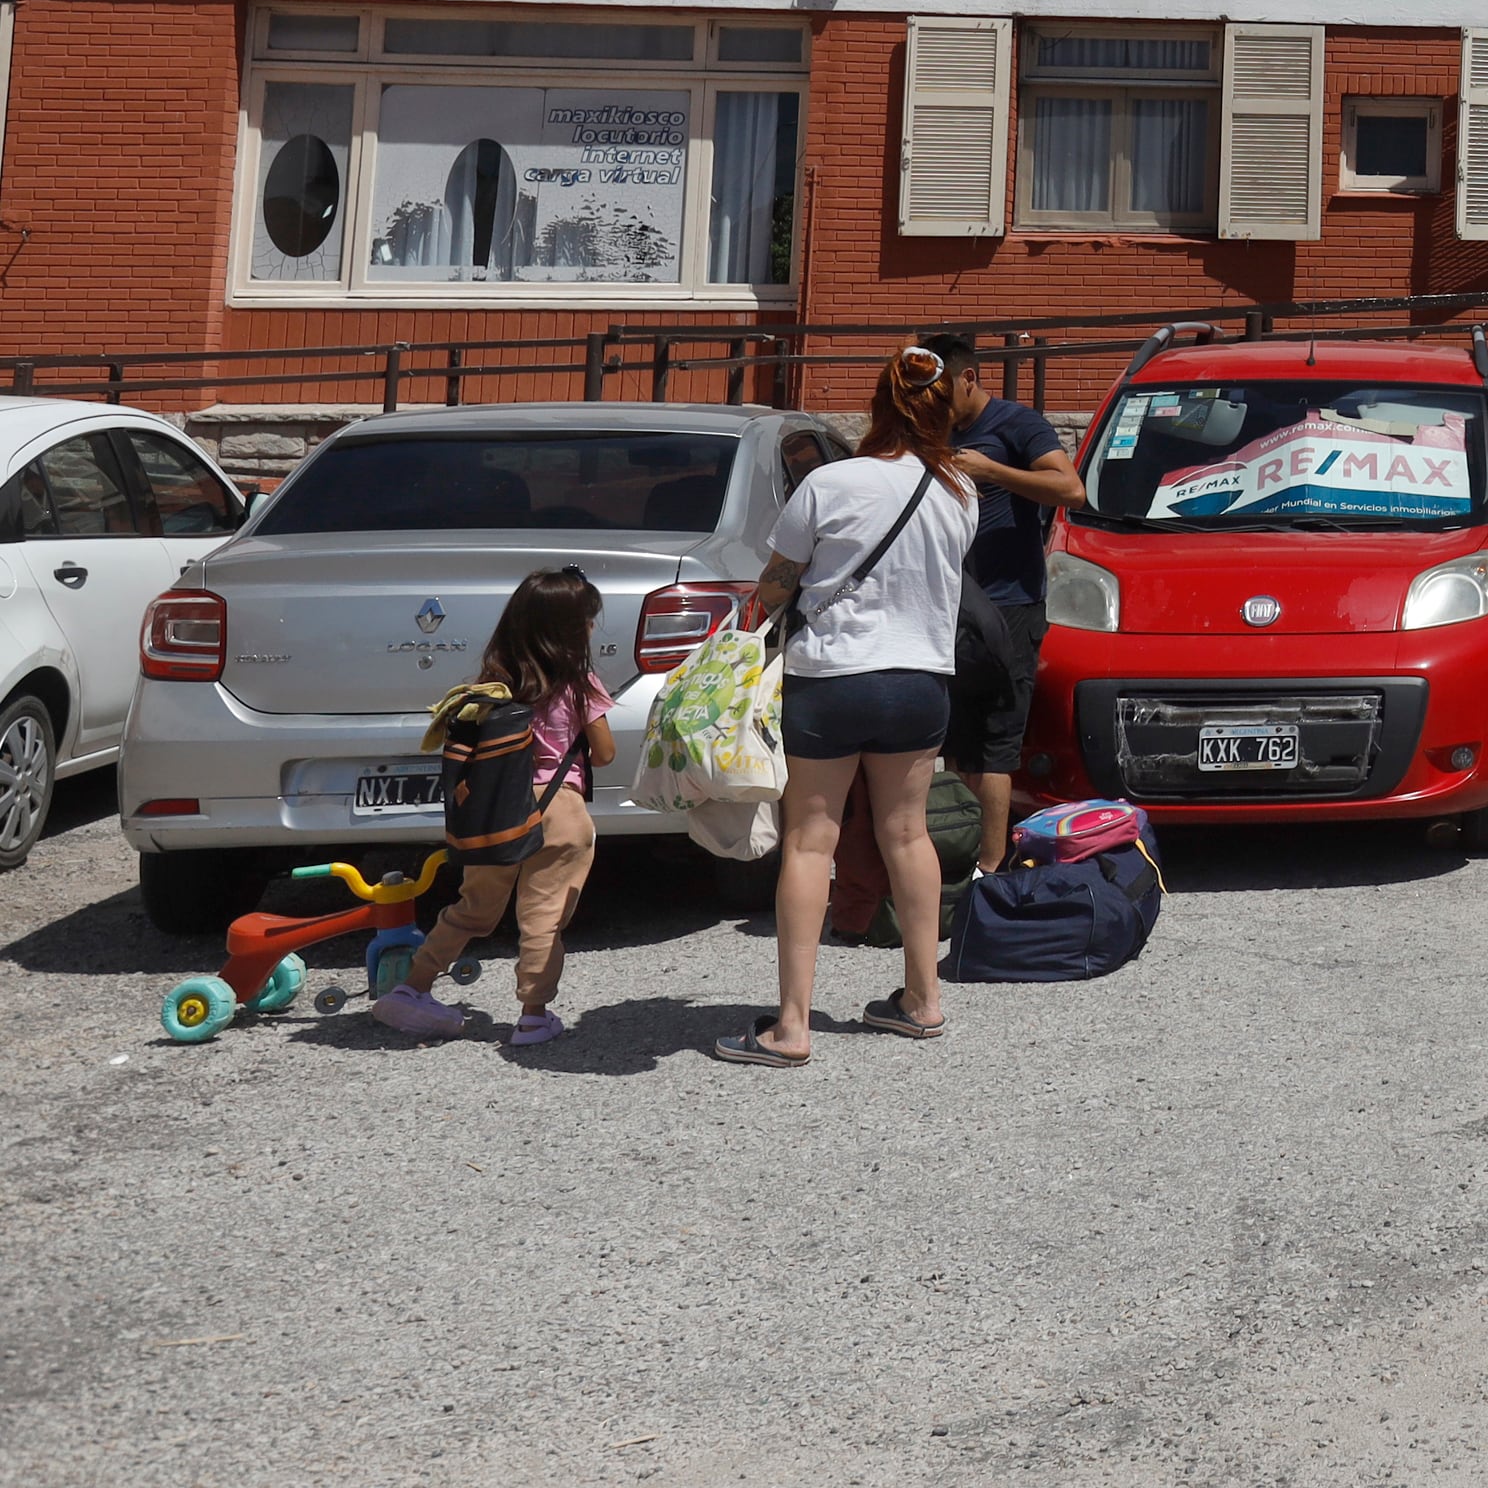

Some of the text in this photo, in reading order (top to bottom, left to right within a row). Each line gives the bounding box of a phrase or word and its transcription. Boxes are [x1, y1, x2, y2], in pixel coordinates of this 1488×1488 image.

[548, 106, 685, 125] maxikiosco
[572, 125, 684, 145] locutorio
[581, 146, 683, 165] internet
[524, 166, 681, 187] carga virtual
[1257, 447, 1453, 491] RE/MAX
[1176, 475, 1241, 498] RE/MAX
[1281, 498, 1322, 509] Mundial
[1324, 502, 1337, 510] en
[1340, 502, 1388, 512] Servicios
[1251, 603, 1272, 618] FIAT
[386, 639, 469, 653] LOGAN
[1203, 737, 1294, 762] KXK 762
[359, 777, 409, 806] NXT
